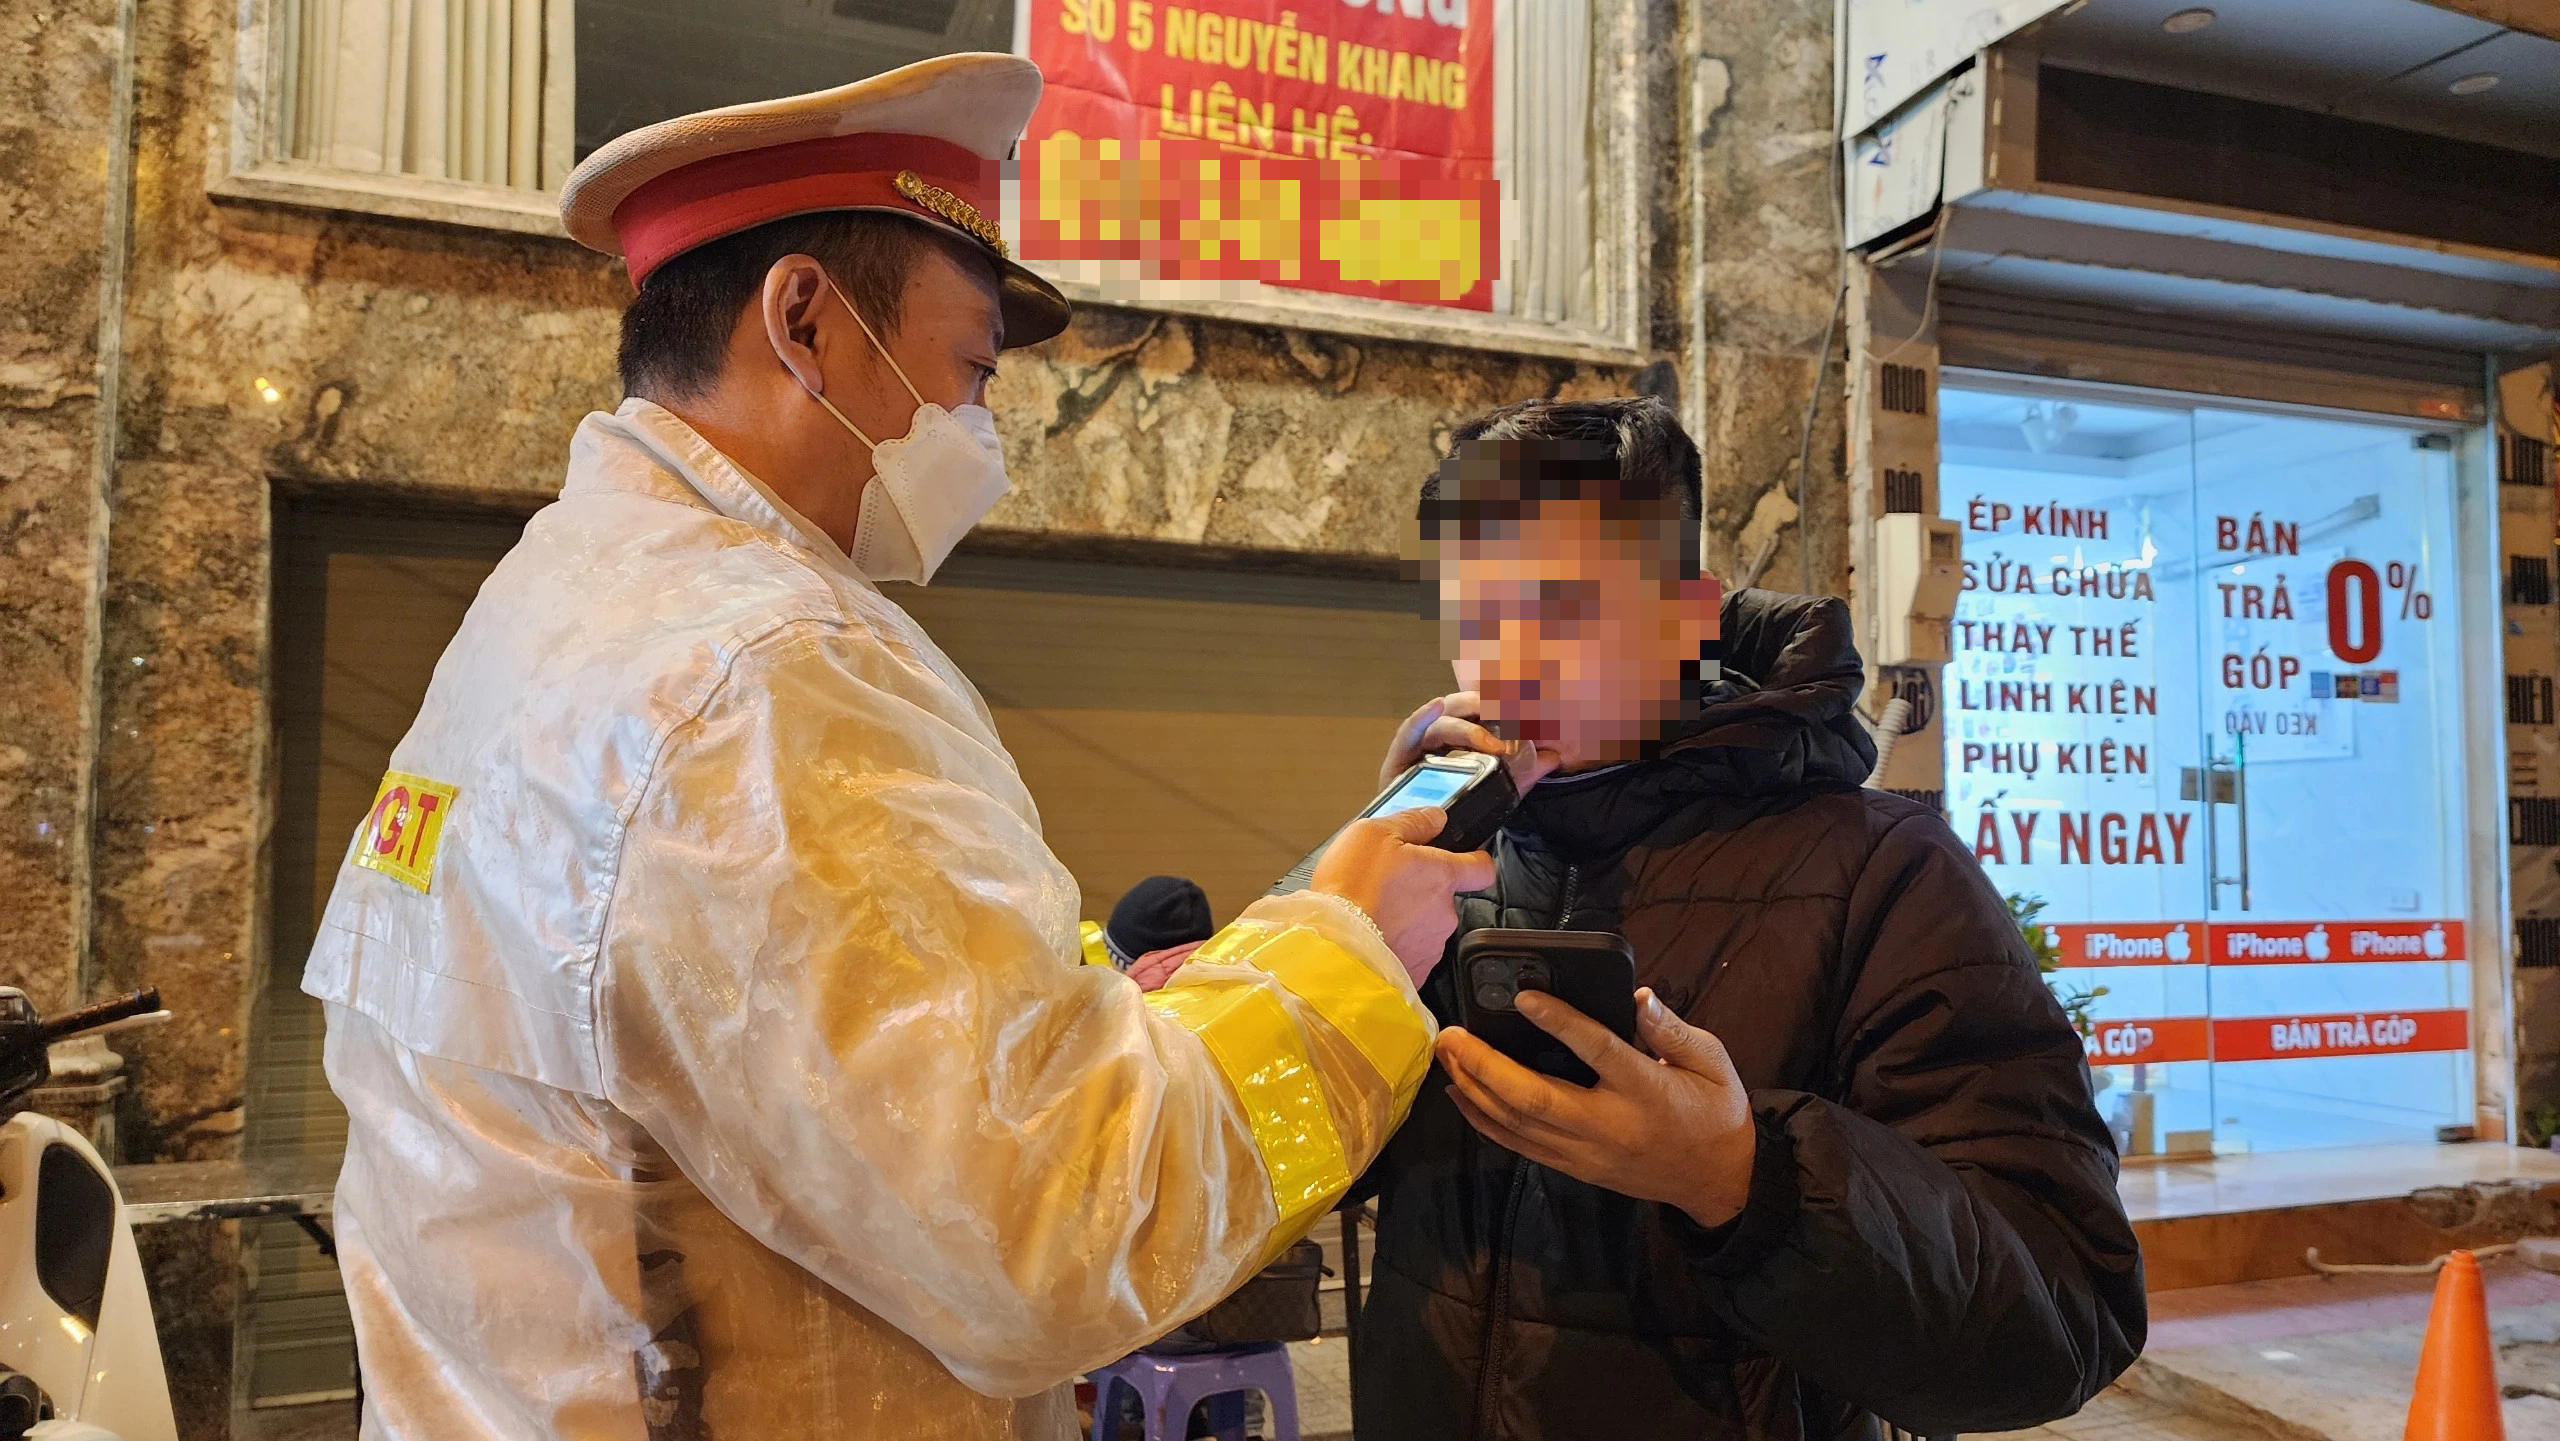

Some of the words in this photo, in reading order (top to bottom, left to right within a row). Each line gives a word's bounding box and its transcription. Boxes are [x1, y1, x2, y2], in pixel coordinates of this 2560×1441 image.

[1127, 0, 1154, 51] 5
[1165, 6, 1328, 84] NGUYỄN
[1337, 40, 1467, 110] KHANG
[1160, 80, 1274, 150] LIÊN
[1968, 494, 2012, 532] ÉP
[2023, 501, 2107, 540] KÍNH
[2216, 512, 2298, 556] BÁN
[1962, 551, 2036, 594] SỬA
[2217, 574, 2294, 620] TRẢ
[1959, 621, 2054, 654] THAY
[2069, 617, 2141, 657] THẾ
[2222, 642, 2299, 690] GÓP
[1961, 680, 2052, 712] LINH
[2068, 677, 2156, 722] KIỆN
[1963, 742, 2038, 780] PHỤ
[2057, 738, 2147, 782] KIỆN
[1970, 788, 2037, 864] ẤY
[2060, 812, 2190, 864] NGAY
[2085, 933, 2163, 959] iPhone
[2227, 932, 2303, 958] iPhone
[2350, 930, 2421, 955] iPhone
[2103, 1022, 2153, 1056] GÓP
[2271, 1018, 2321, 1050] BÁN
[2322, 1013, 2370, 1047] TRẢ
[2372, 1014, 2417, 1045] GÓP
